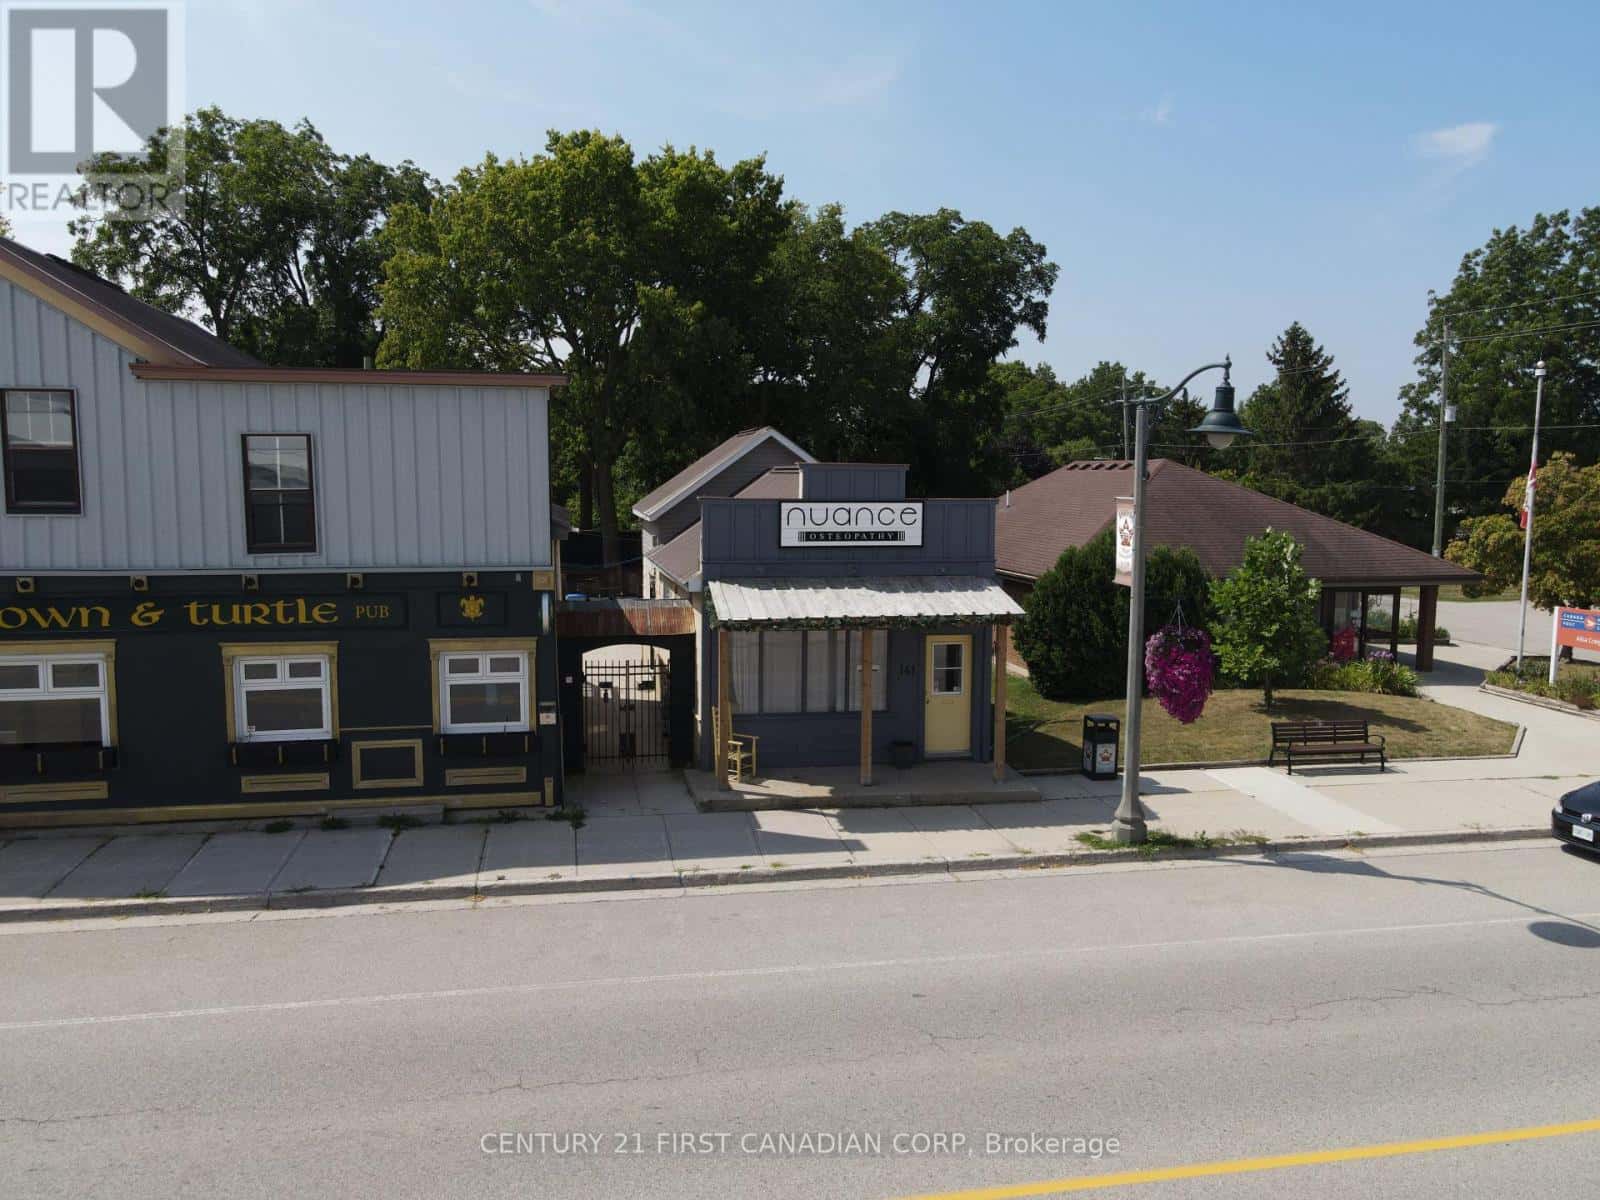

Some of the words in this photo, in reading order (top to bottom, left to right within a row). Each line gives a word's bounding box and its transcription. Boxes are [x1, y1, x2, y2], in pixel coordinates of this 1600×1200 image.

[786, 506, 918, 527] nuance
[808, 532, 896, 541] OSTEOPATHY
[130, 601, 165, 627] &
[355, 605, 390, 619] PUB
